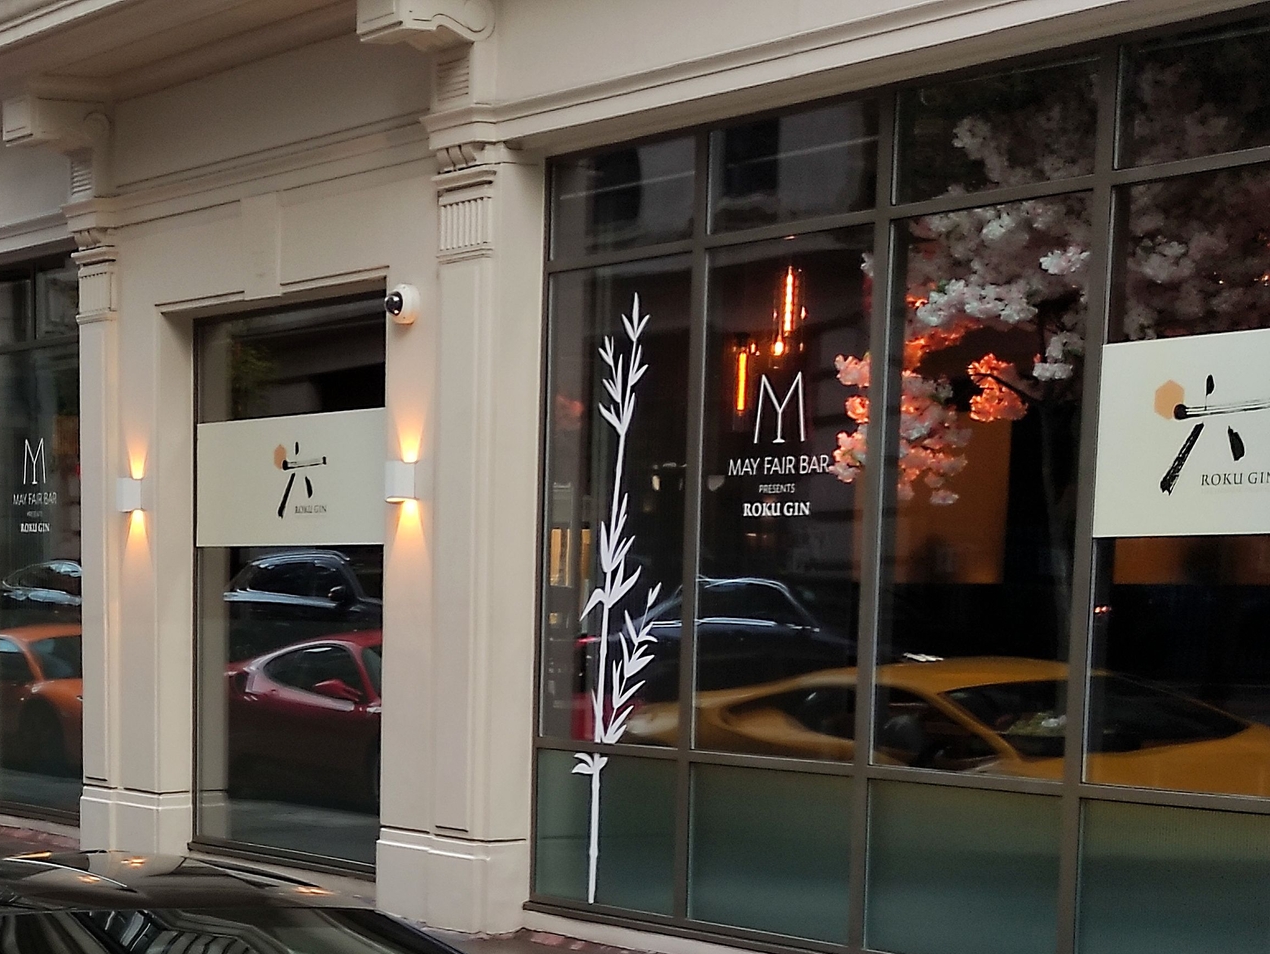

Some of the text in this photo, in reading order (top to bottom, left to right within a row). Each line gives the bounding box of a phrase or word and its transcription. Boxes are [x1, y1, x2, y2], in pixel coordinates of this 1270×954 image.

[728, 455, 830, 476] MAY FAIR BAR
[1201, 472, 1243, 486] ROKU
[758, 483, 796, 494] PRESENTS
[13, 493, 27, 505] MAY
[43, 491, 57, 504] BAR
[743, 501, 811, 517] ROKU GIN
